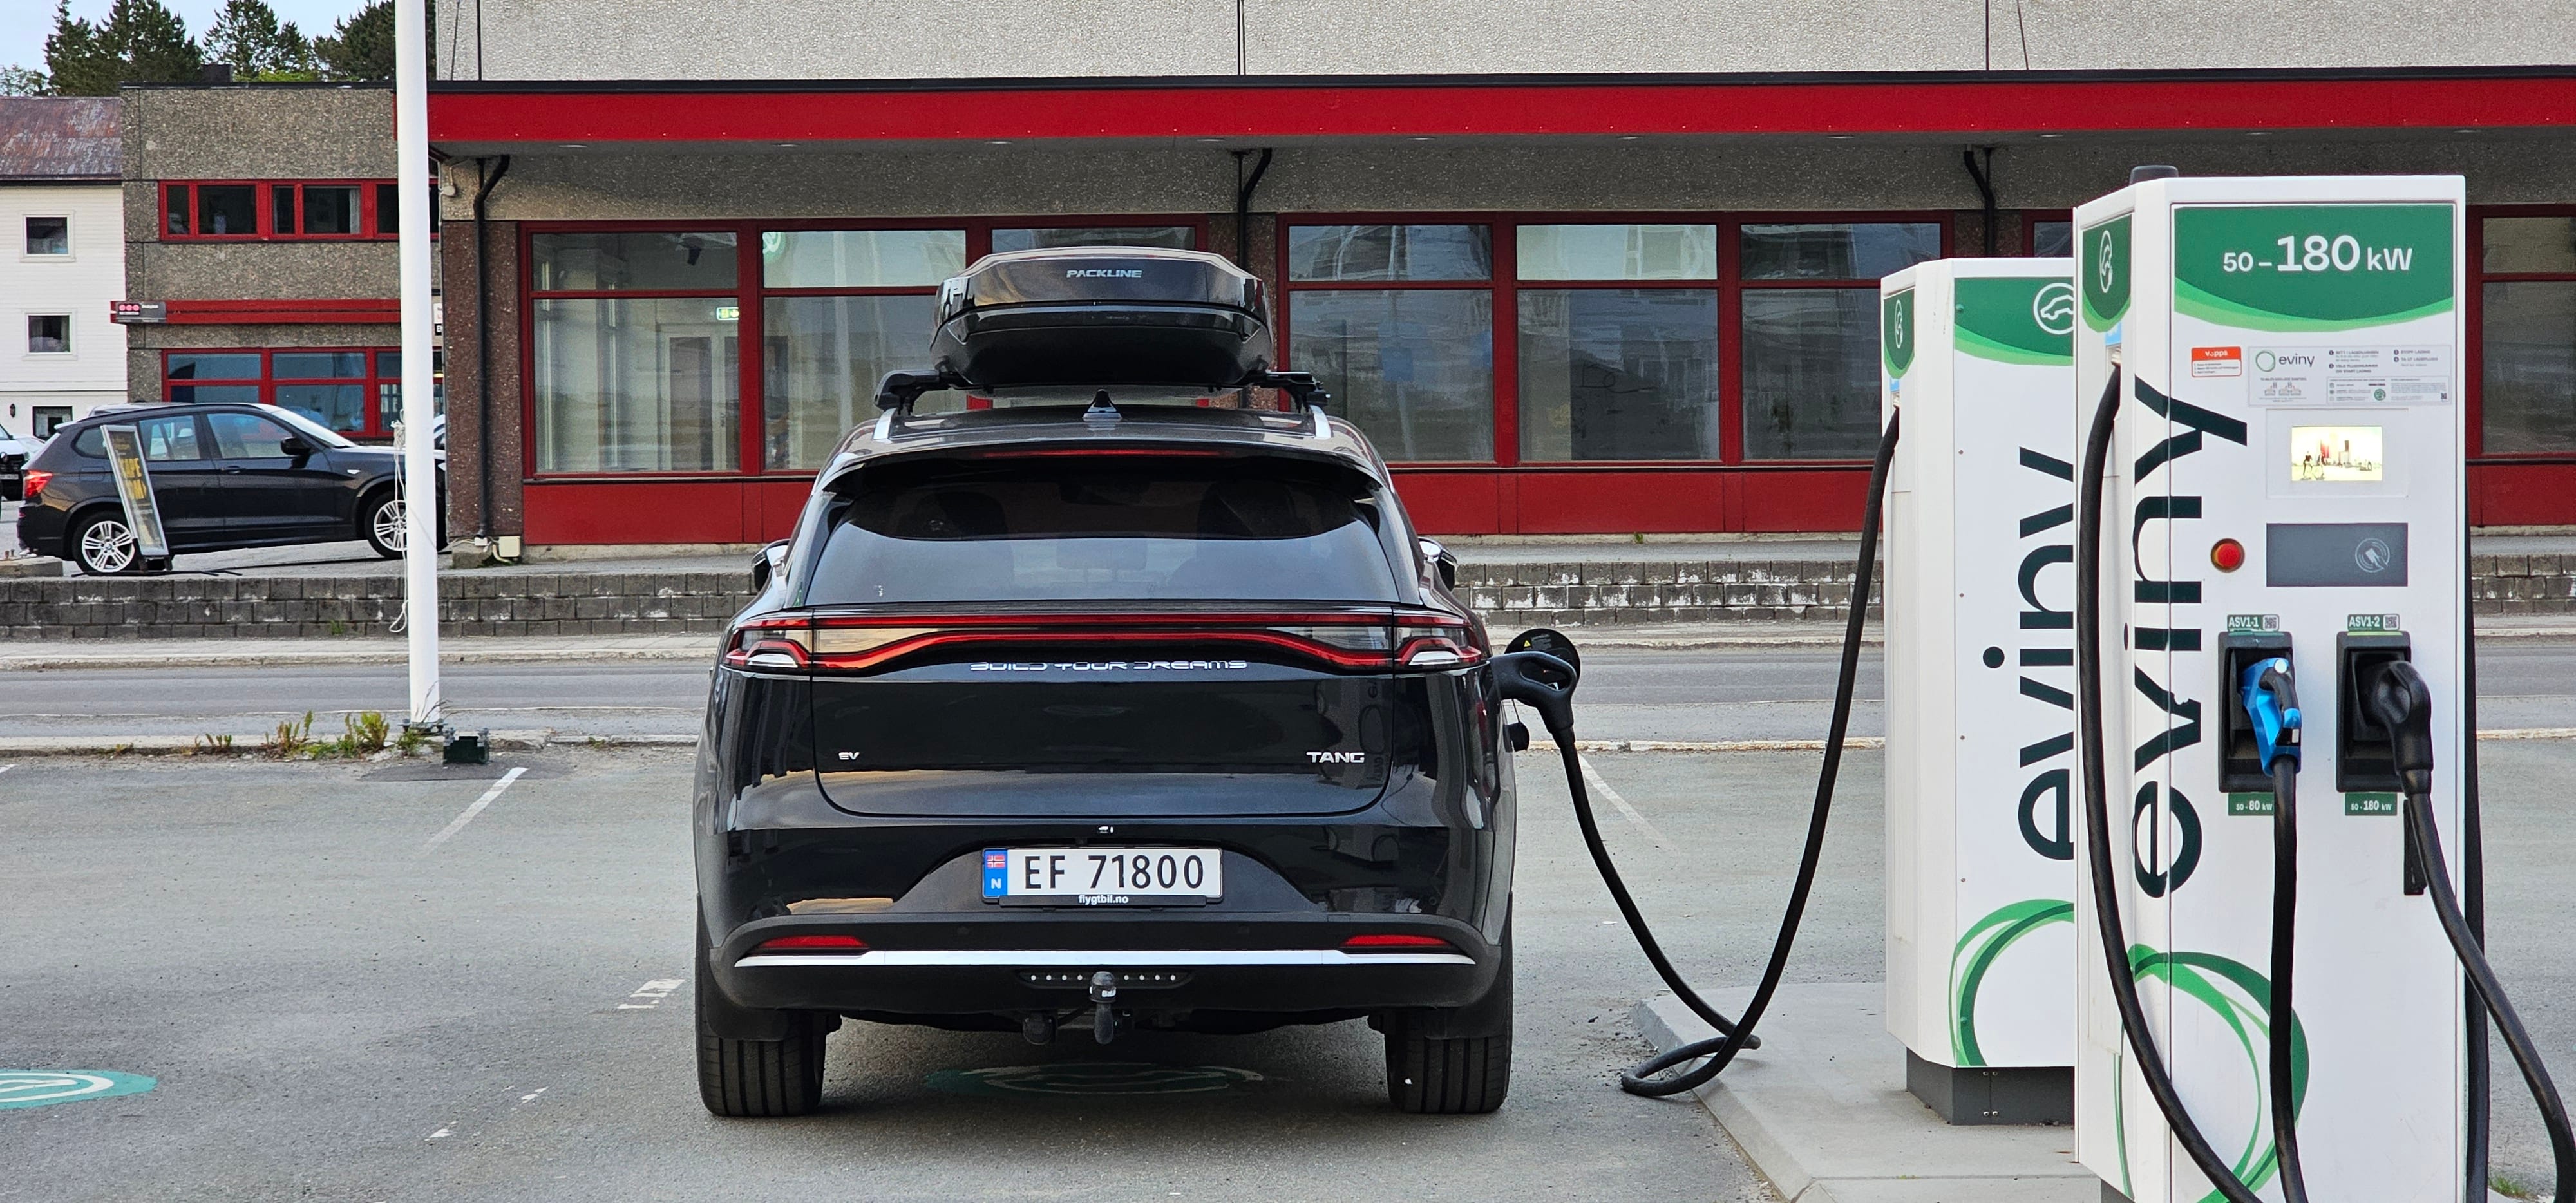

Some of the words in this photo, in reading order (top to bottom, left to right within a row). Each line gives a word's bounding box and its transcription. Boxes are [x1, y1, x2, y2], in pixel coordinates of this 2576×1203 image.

[2223, 252, 2253, 272] 50
[2278, 234, 2360, 272] 180
[2367, 247, 2412, 271] kW
[2278, 354, 2315, 367] eviny
[2228, 616, 2259, 627] ASV1-1
[2349, 616, 2380, 627] ASV1-2
[2124, 373, 2248, 898] eviny
[971, 662, 1048, 670] BUILD
[1054, 661, 1128, 670] YOUR
[1133, 661, 1248, 670] DREAMS
[838, 752, 860, 760] EV
[1306, 752, 1365, 763] TANG
[2249, 800, 2260, 810] 80
[2363, 800, 2380, 810] 180
[1025, 855, 1065, 889] EF
[1088, 855, 1203, 889] 71800
[990, 878, 1002, 889] N
[1078, 894, 1129, 905] flygtbil.no
